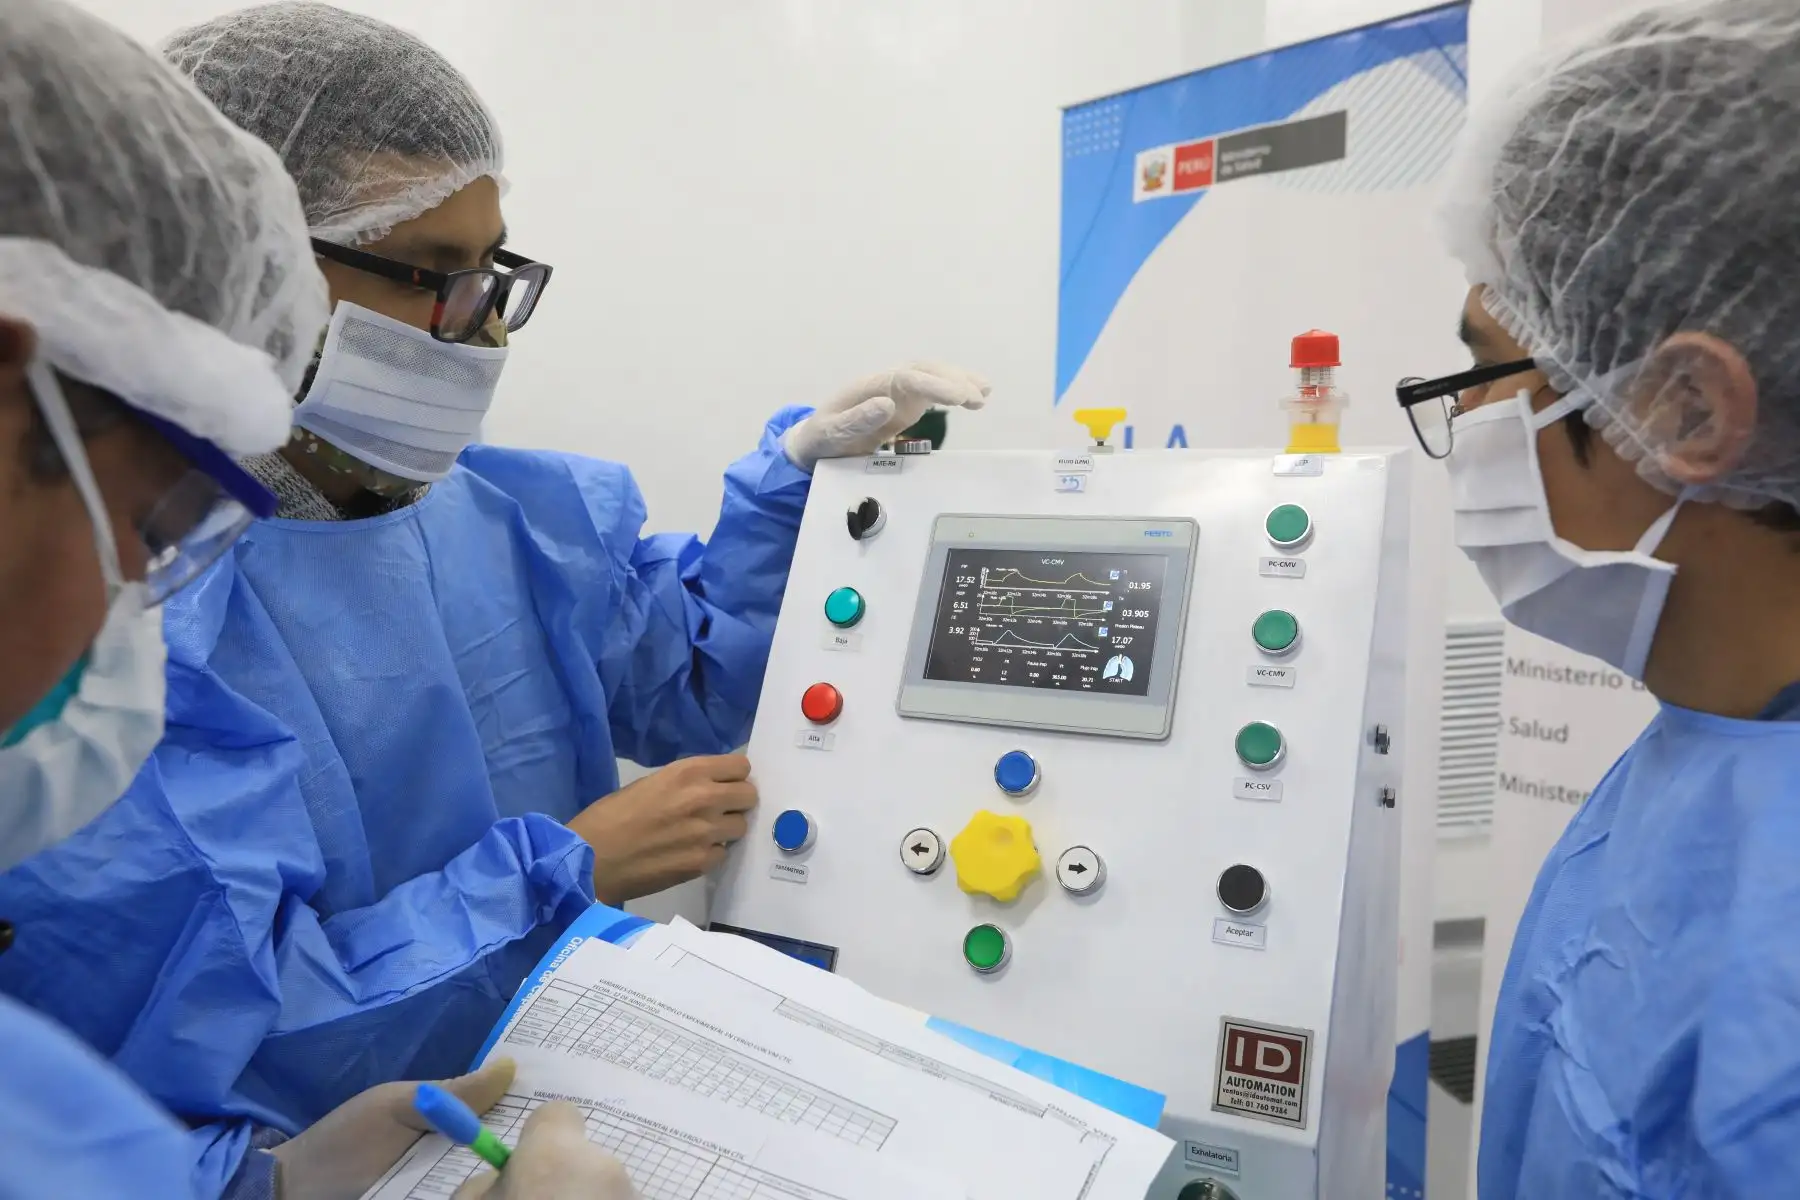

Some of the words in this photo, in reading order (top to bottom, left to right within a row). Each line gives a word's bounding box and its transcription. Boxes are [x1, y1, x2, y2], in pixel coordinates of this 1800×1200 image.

[1268, 560, 1297, 568] PC-CMV
[956, 576, 976, 584] 17.52
[1129, 582, 1151, 590] 01.95
[1122, 610, 1150, 618] 03.905
[948, 627, 965, 635] 3.92
[1111, 636, 1133, 644] 17.07
[1256, 669, 1286, 678] VC-CMV
[1506, 657, 1623, 690] Ministerio
[1509, 716, 1569, 744] Salud
[1244, 782, 1272, 791] PC-CSV
[1225, 926, 1254, 938] Aceptar
[550, 936, 584, 968] Oficina
[1234, 1036, 1292, 1074] ID
[1226, 1075, 1297, 1098] AUTOMATION
[1245, 1100, 1254, 1108] 01
[1256, 1101, 1269, 1111] 760
[1191, 1146, 1232, 1162] Exhalatoria
